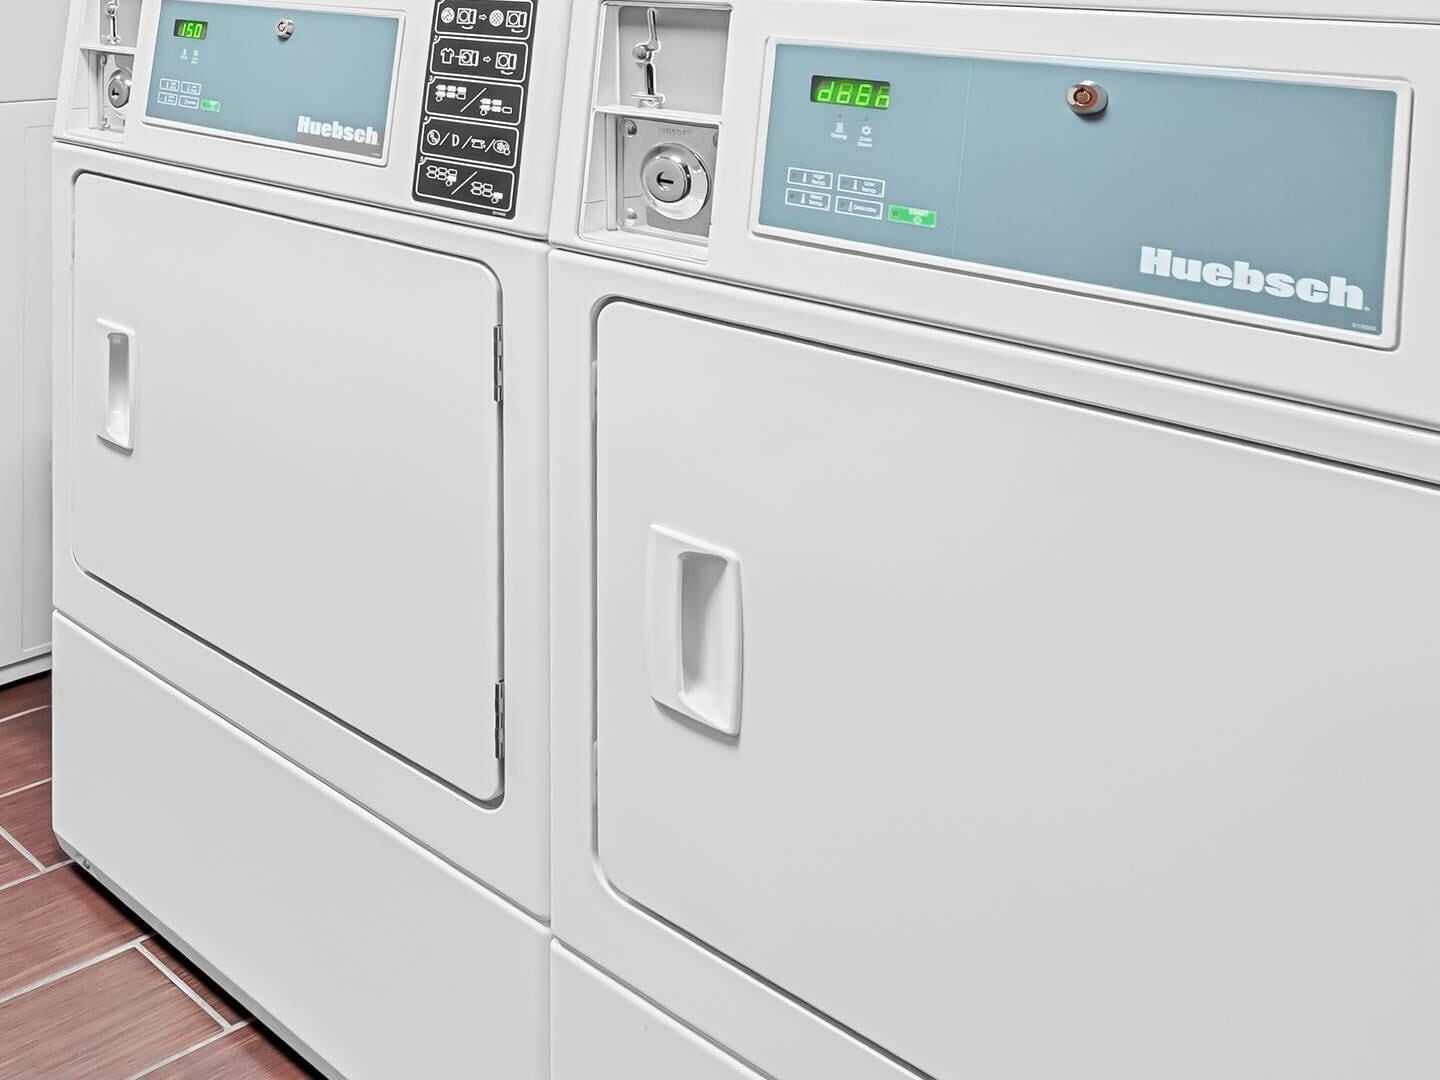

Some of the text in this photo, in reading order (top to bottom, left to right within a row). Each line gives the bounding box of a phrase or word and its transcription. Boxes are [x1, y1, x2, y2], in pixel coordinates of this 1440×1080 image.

[181, 22, 203, 38] 150
[297, 115, 379, 145] Huebsch
[1139, 245, 1364, 311] Huebsch
